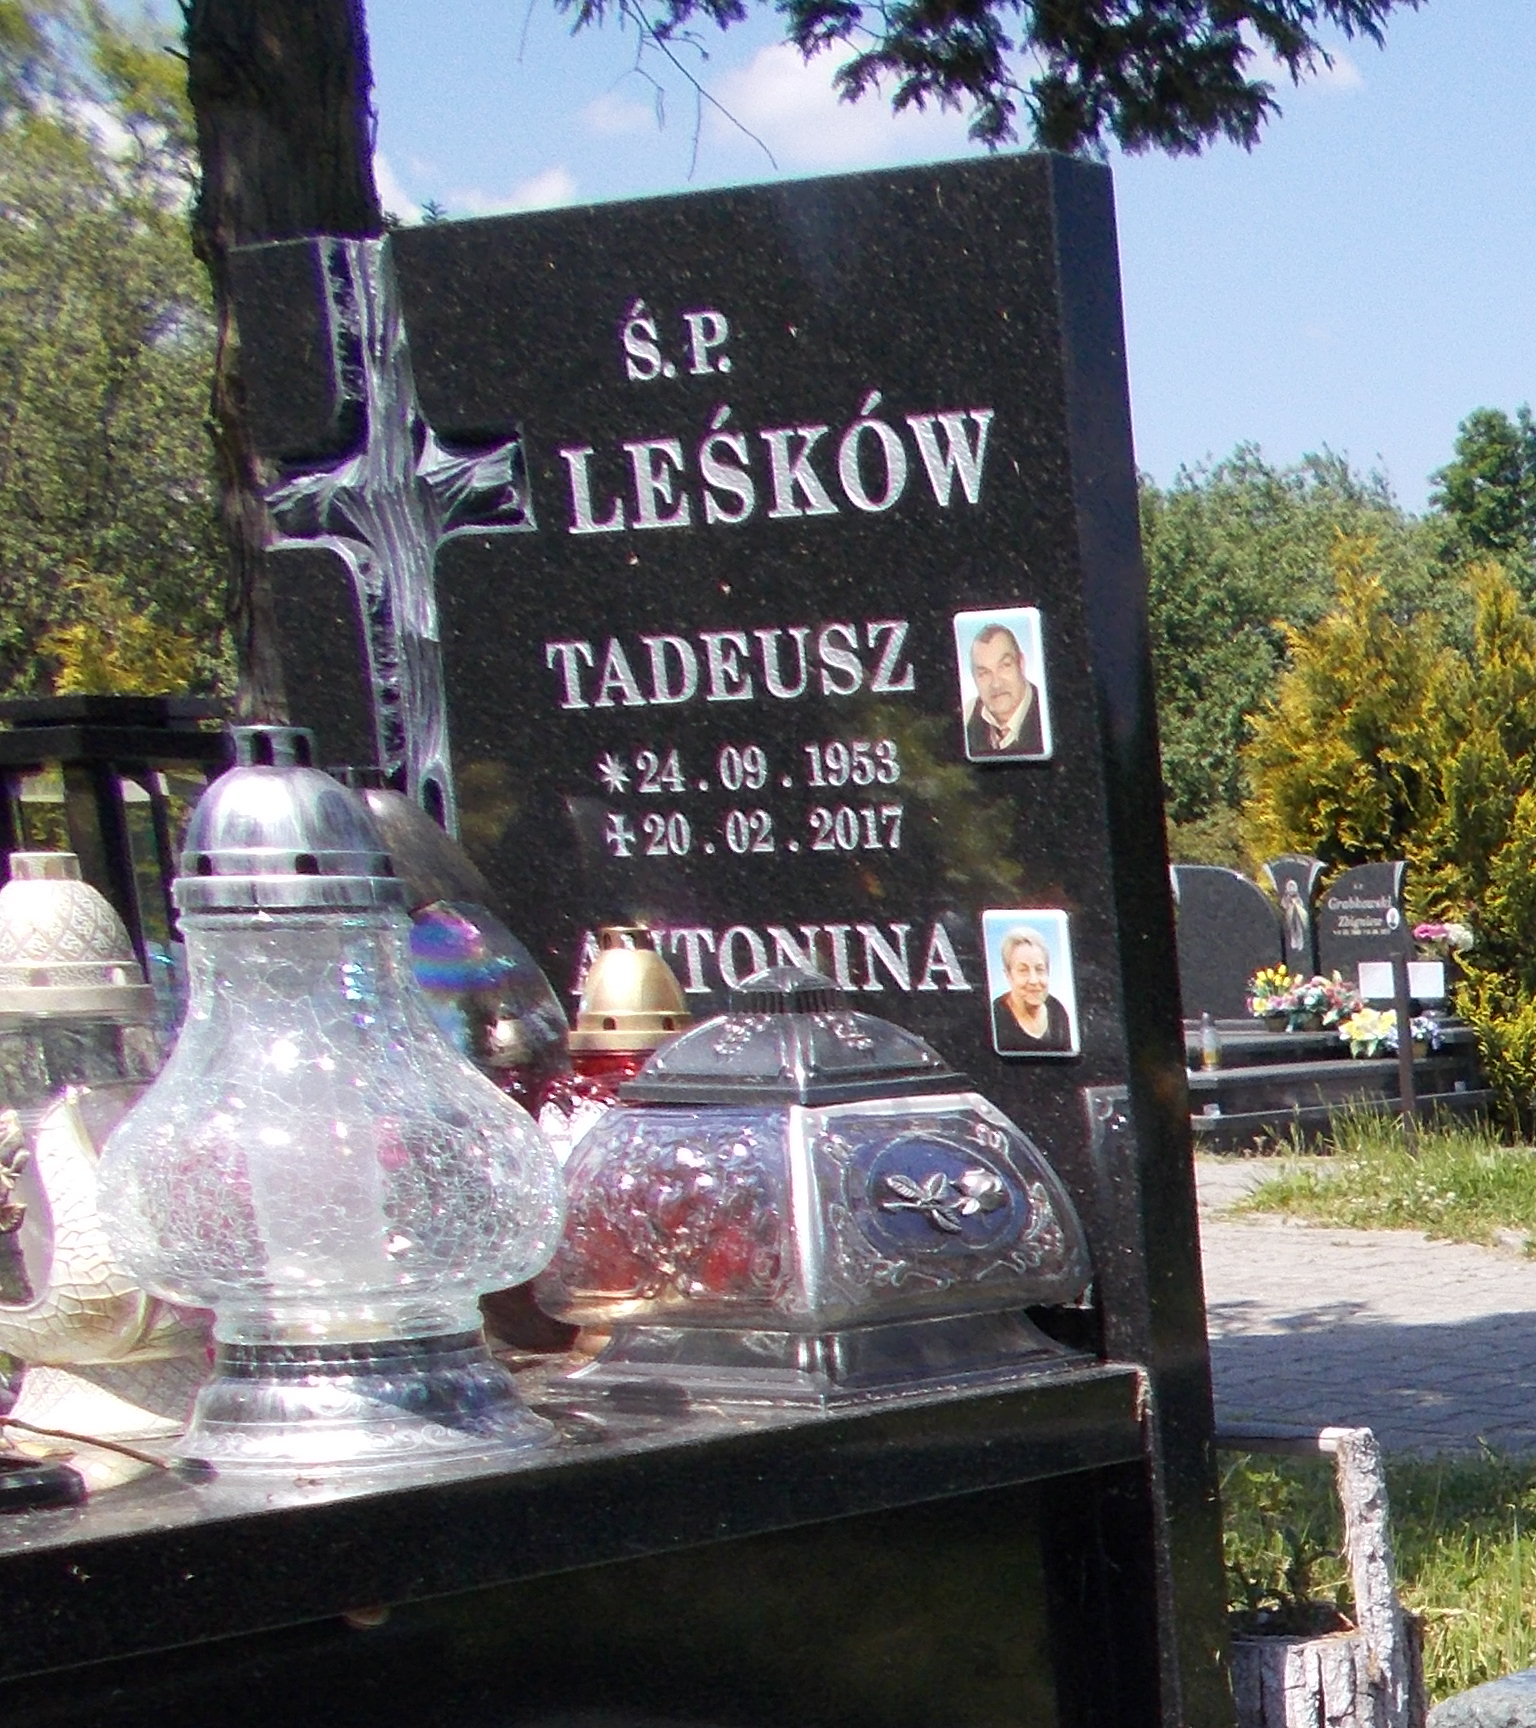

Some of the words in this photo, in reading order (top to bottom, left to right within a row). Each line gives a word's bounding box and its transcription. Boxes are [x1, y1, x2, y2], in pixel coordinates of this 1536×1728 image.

[560, 392, 995, 533] LEŚKÓW
[547, 621, 915, 710] TADEUSZ
[572, 923, 971, 995] ATONINA
